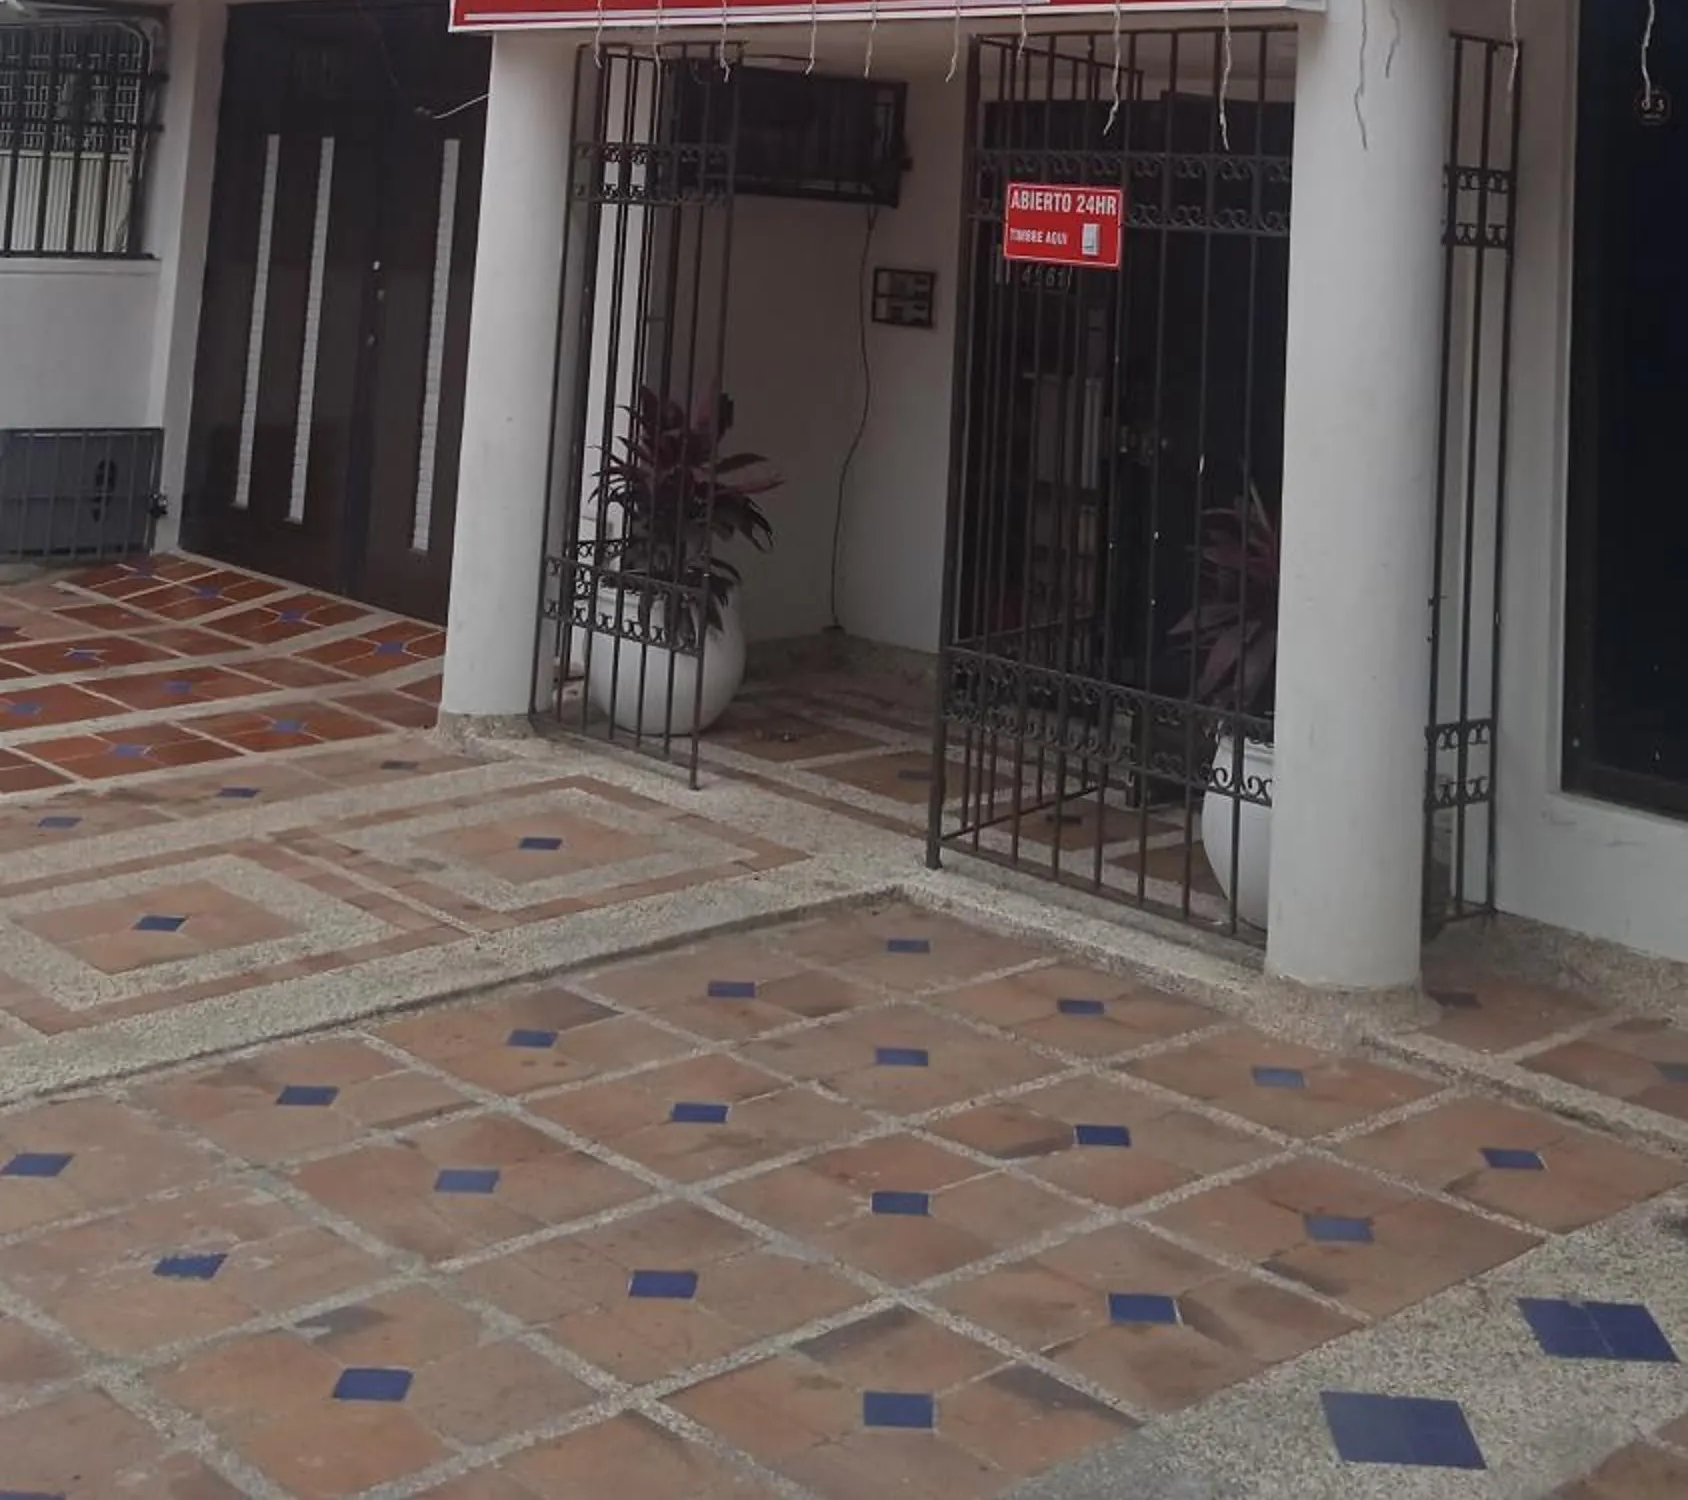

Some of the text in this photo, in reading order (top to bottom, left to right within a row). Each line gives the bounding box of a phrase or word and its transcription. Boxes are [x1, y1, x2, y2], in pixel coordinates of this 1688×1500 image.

[1010, 189, 1117, 216] ABIERTO 24HR
[1009, 227, 1043, 243] TIMBRE
